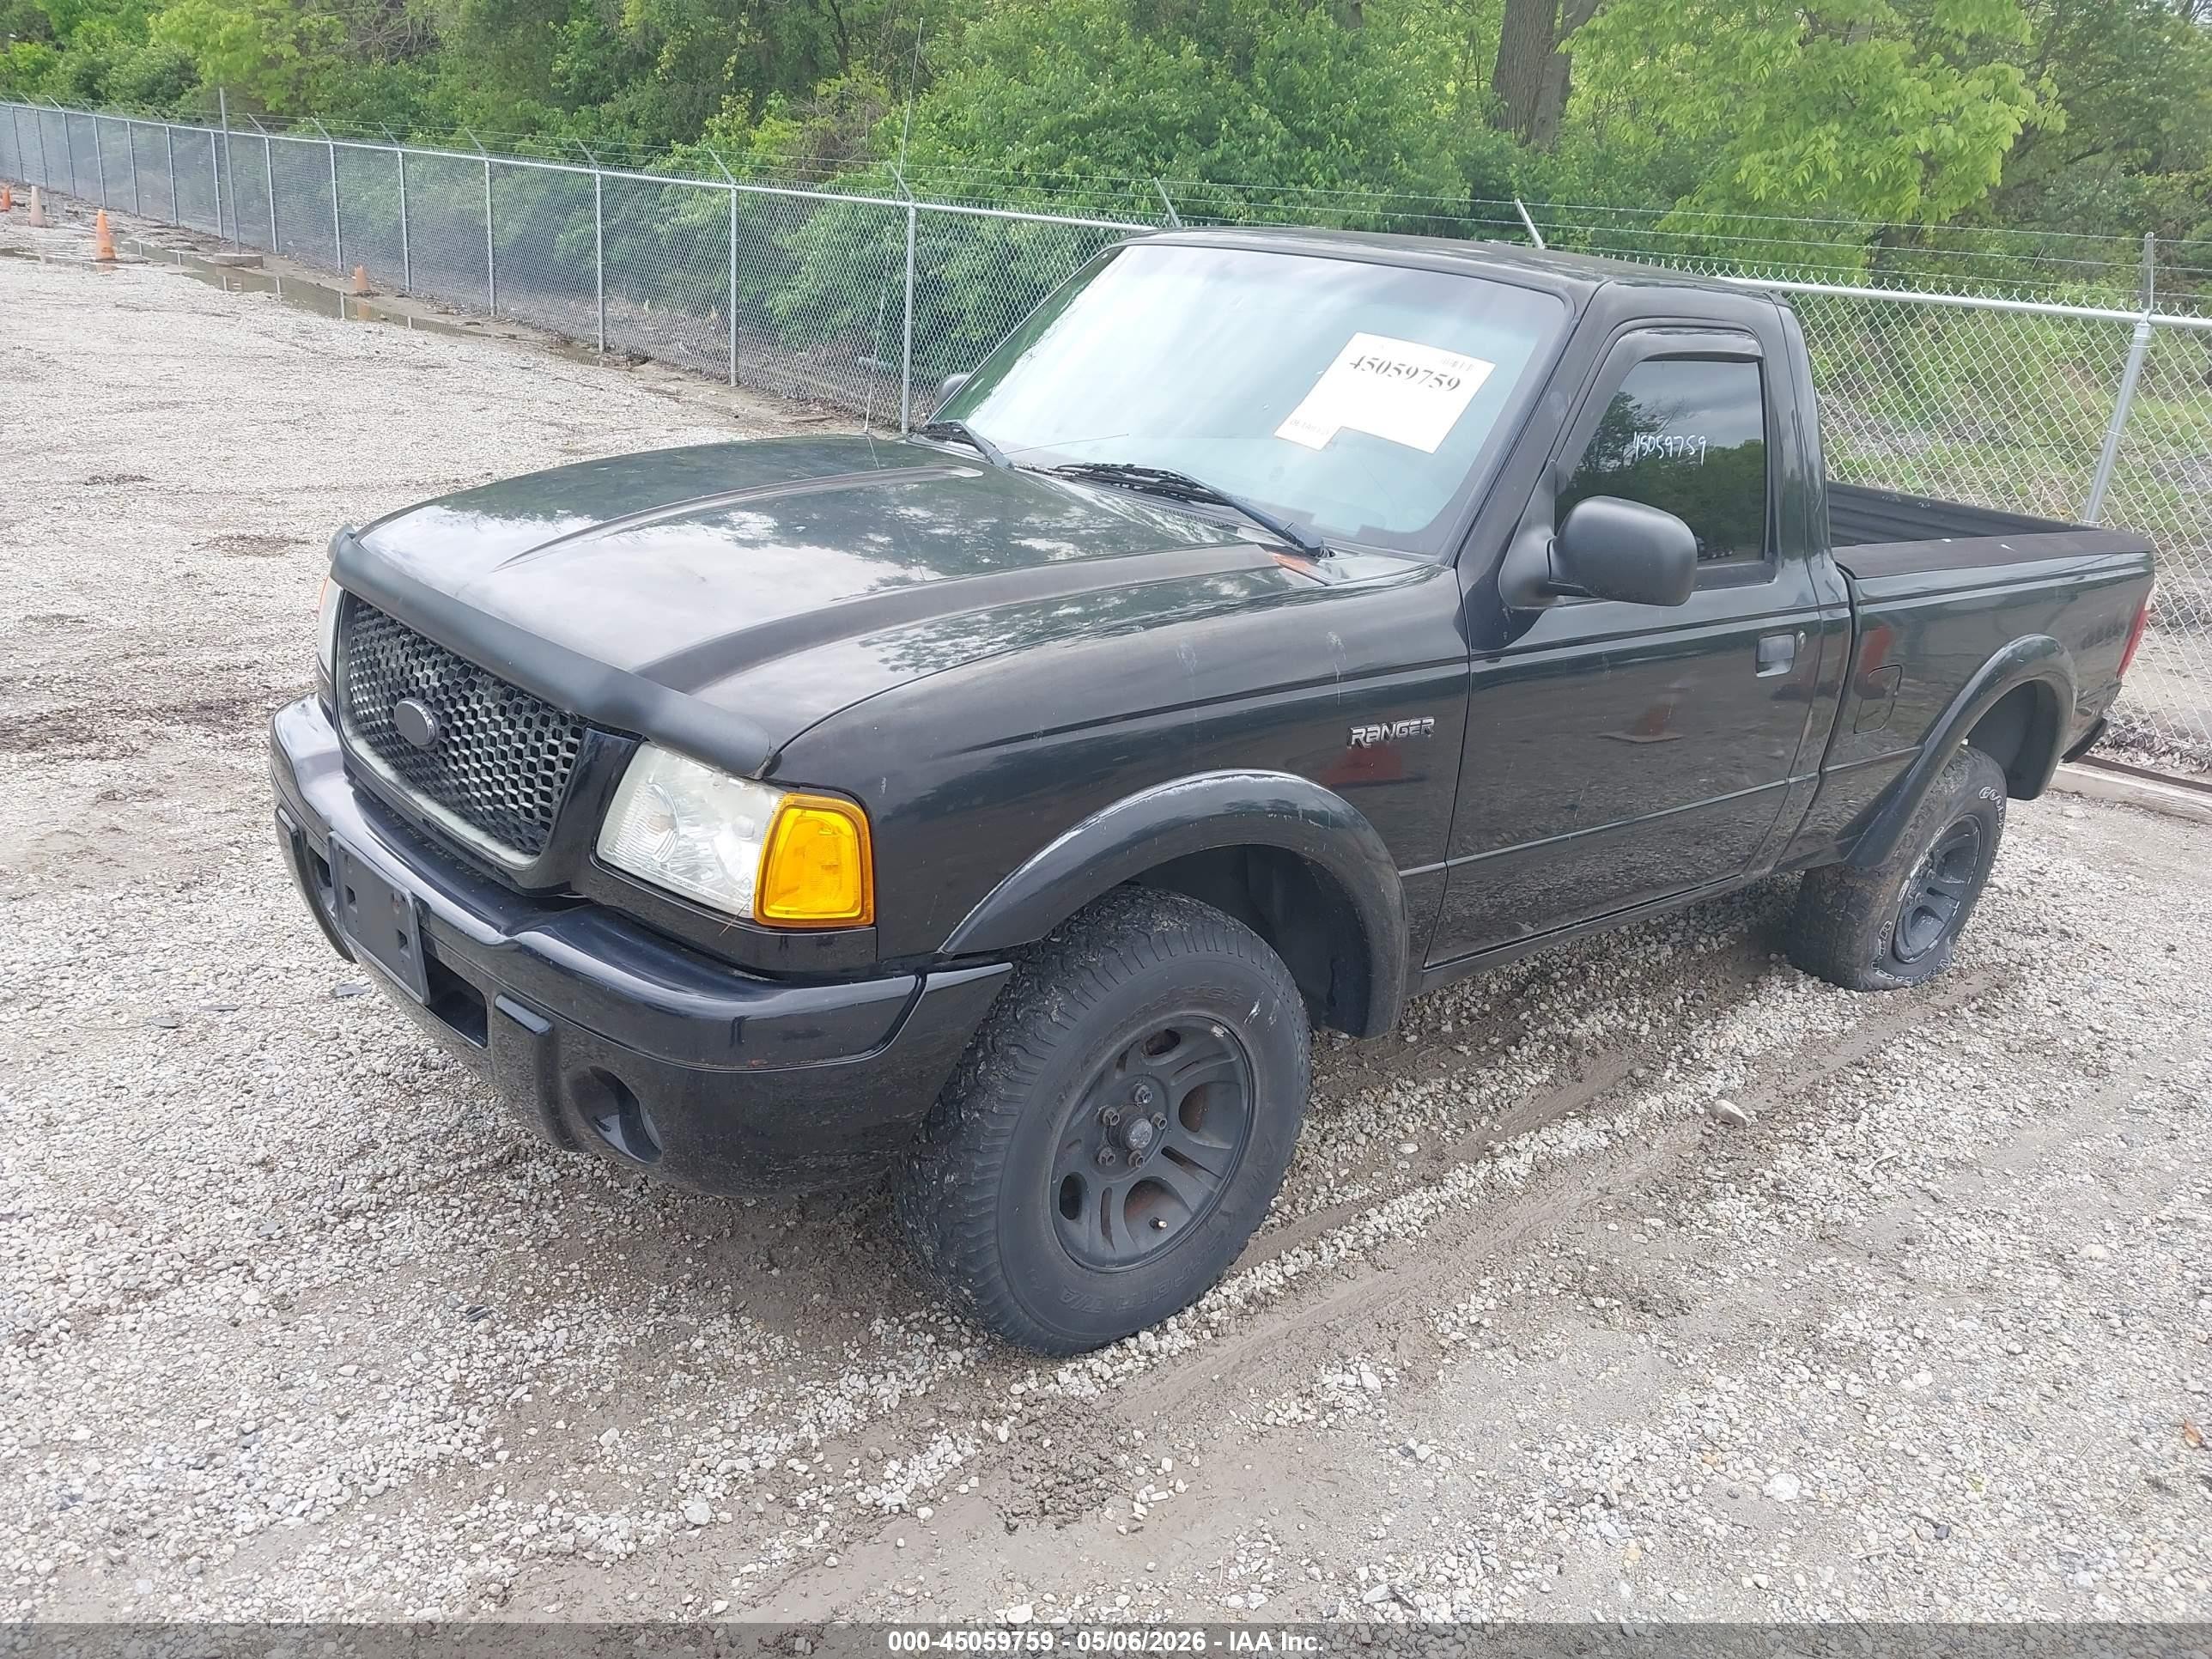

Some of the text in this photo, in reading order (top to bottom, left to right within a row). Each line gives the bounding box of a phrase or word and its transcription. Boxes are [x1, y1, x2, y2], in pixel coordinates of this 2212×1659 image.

[1349, 355, 1461, 392] 45059759
[1632, 430, 1707, 467] 45059759
[1346, 716, 1436, 749] RANGER
